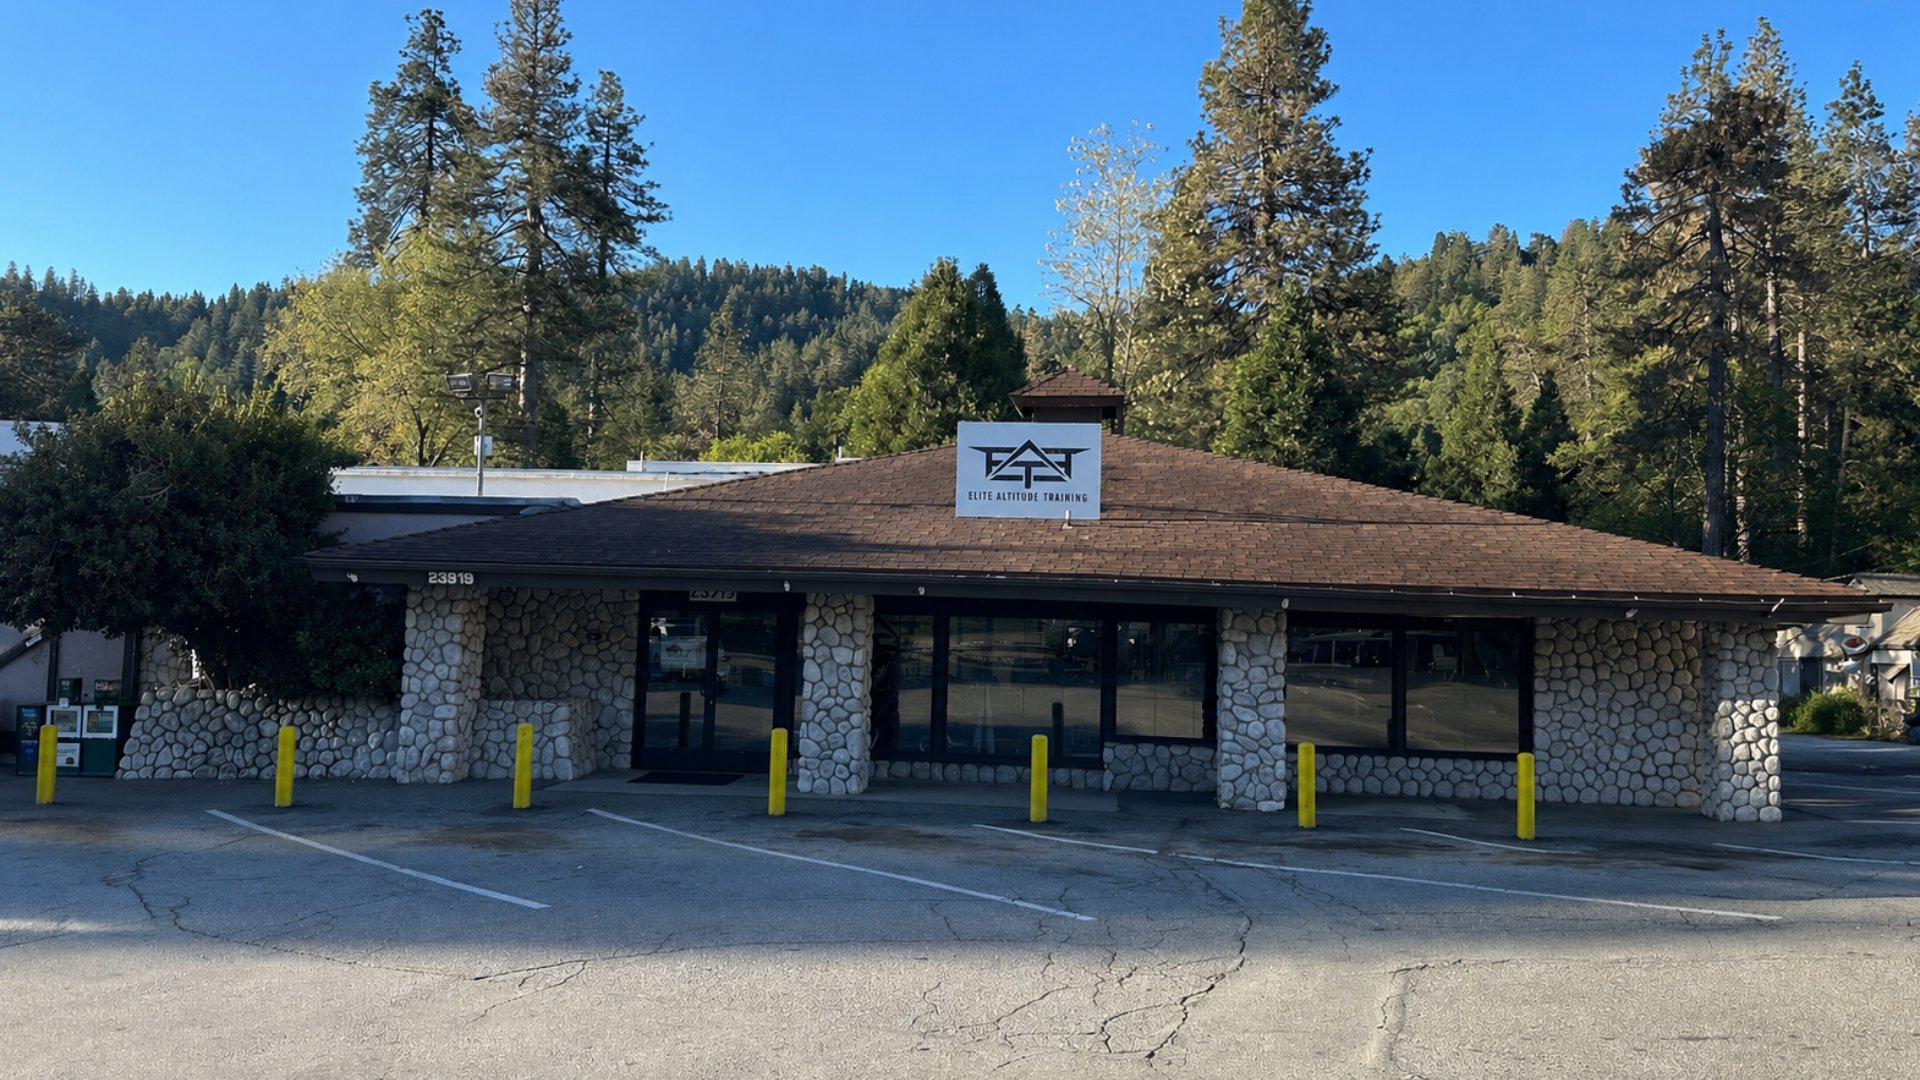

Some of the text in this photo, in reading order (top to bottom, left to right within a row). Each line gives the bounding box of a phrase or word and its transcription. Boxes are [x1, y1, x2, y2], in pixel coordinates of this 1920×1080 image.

[968, 491, 1088, 503] ELITE ALTITUDE TRAINING
[428, 571, 474, 585] 23919
